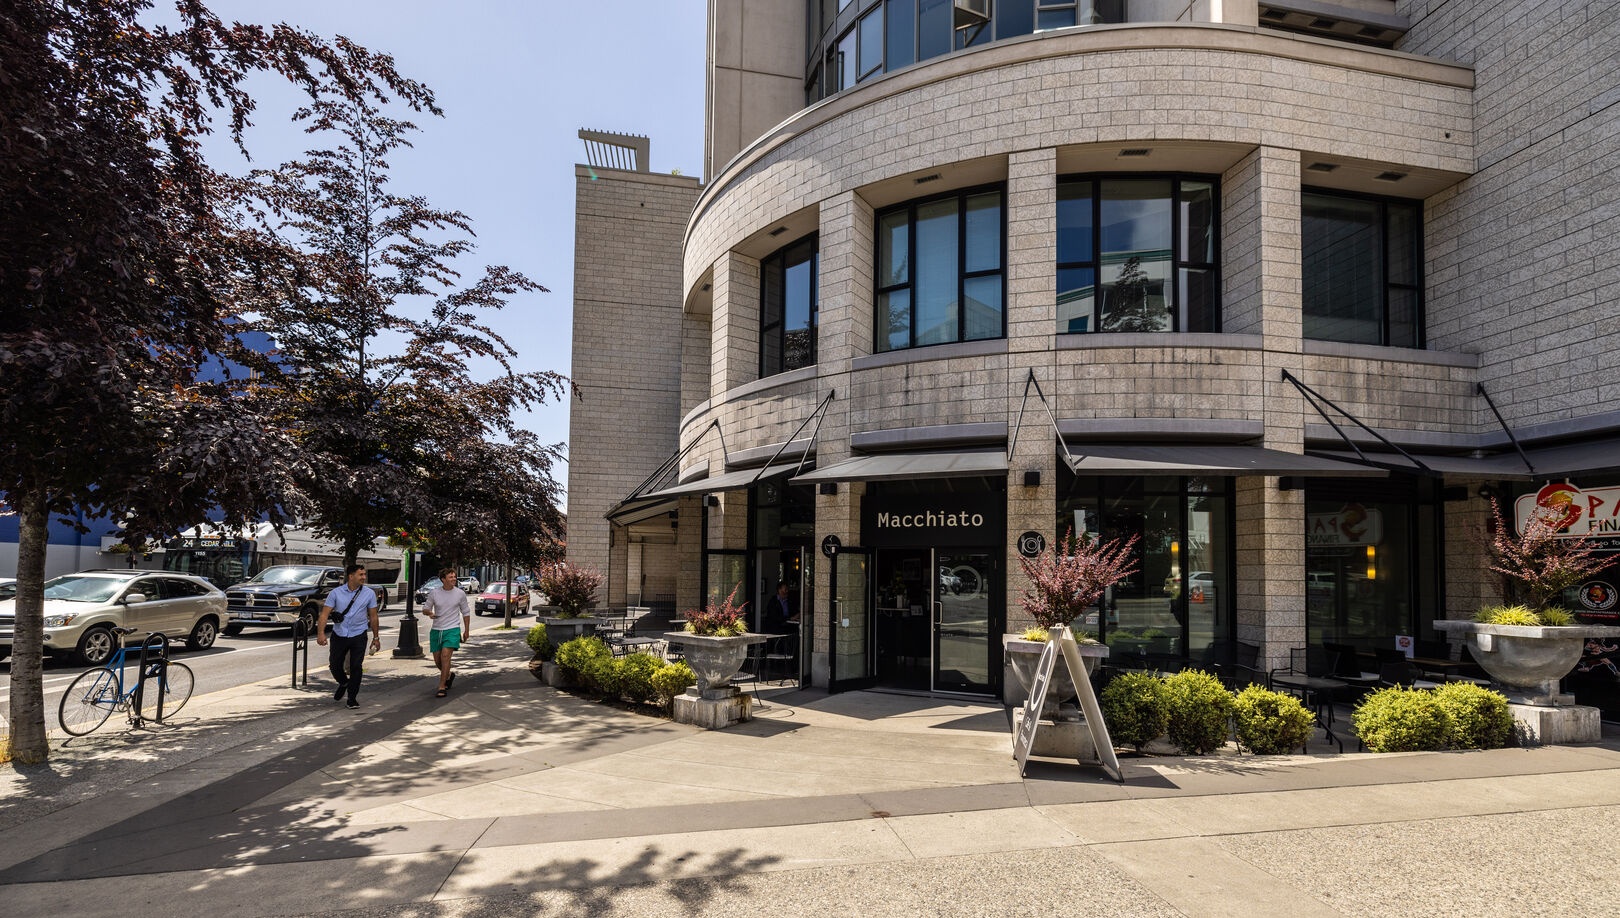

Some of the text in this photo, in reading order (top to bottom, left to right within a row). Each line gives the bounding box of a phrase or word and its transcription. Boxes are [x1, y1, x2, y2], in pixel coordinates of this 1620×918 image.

[877, 510, 984, 528] Macchiato
[1588, 519, 1620, 533] FIN
[182, 539, 194, 548] 24
